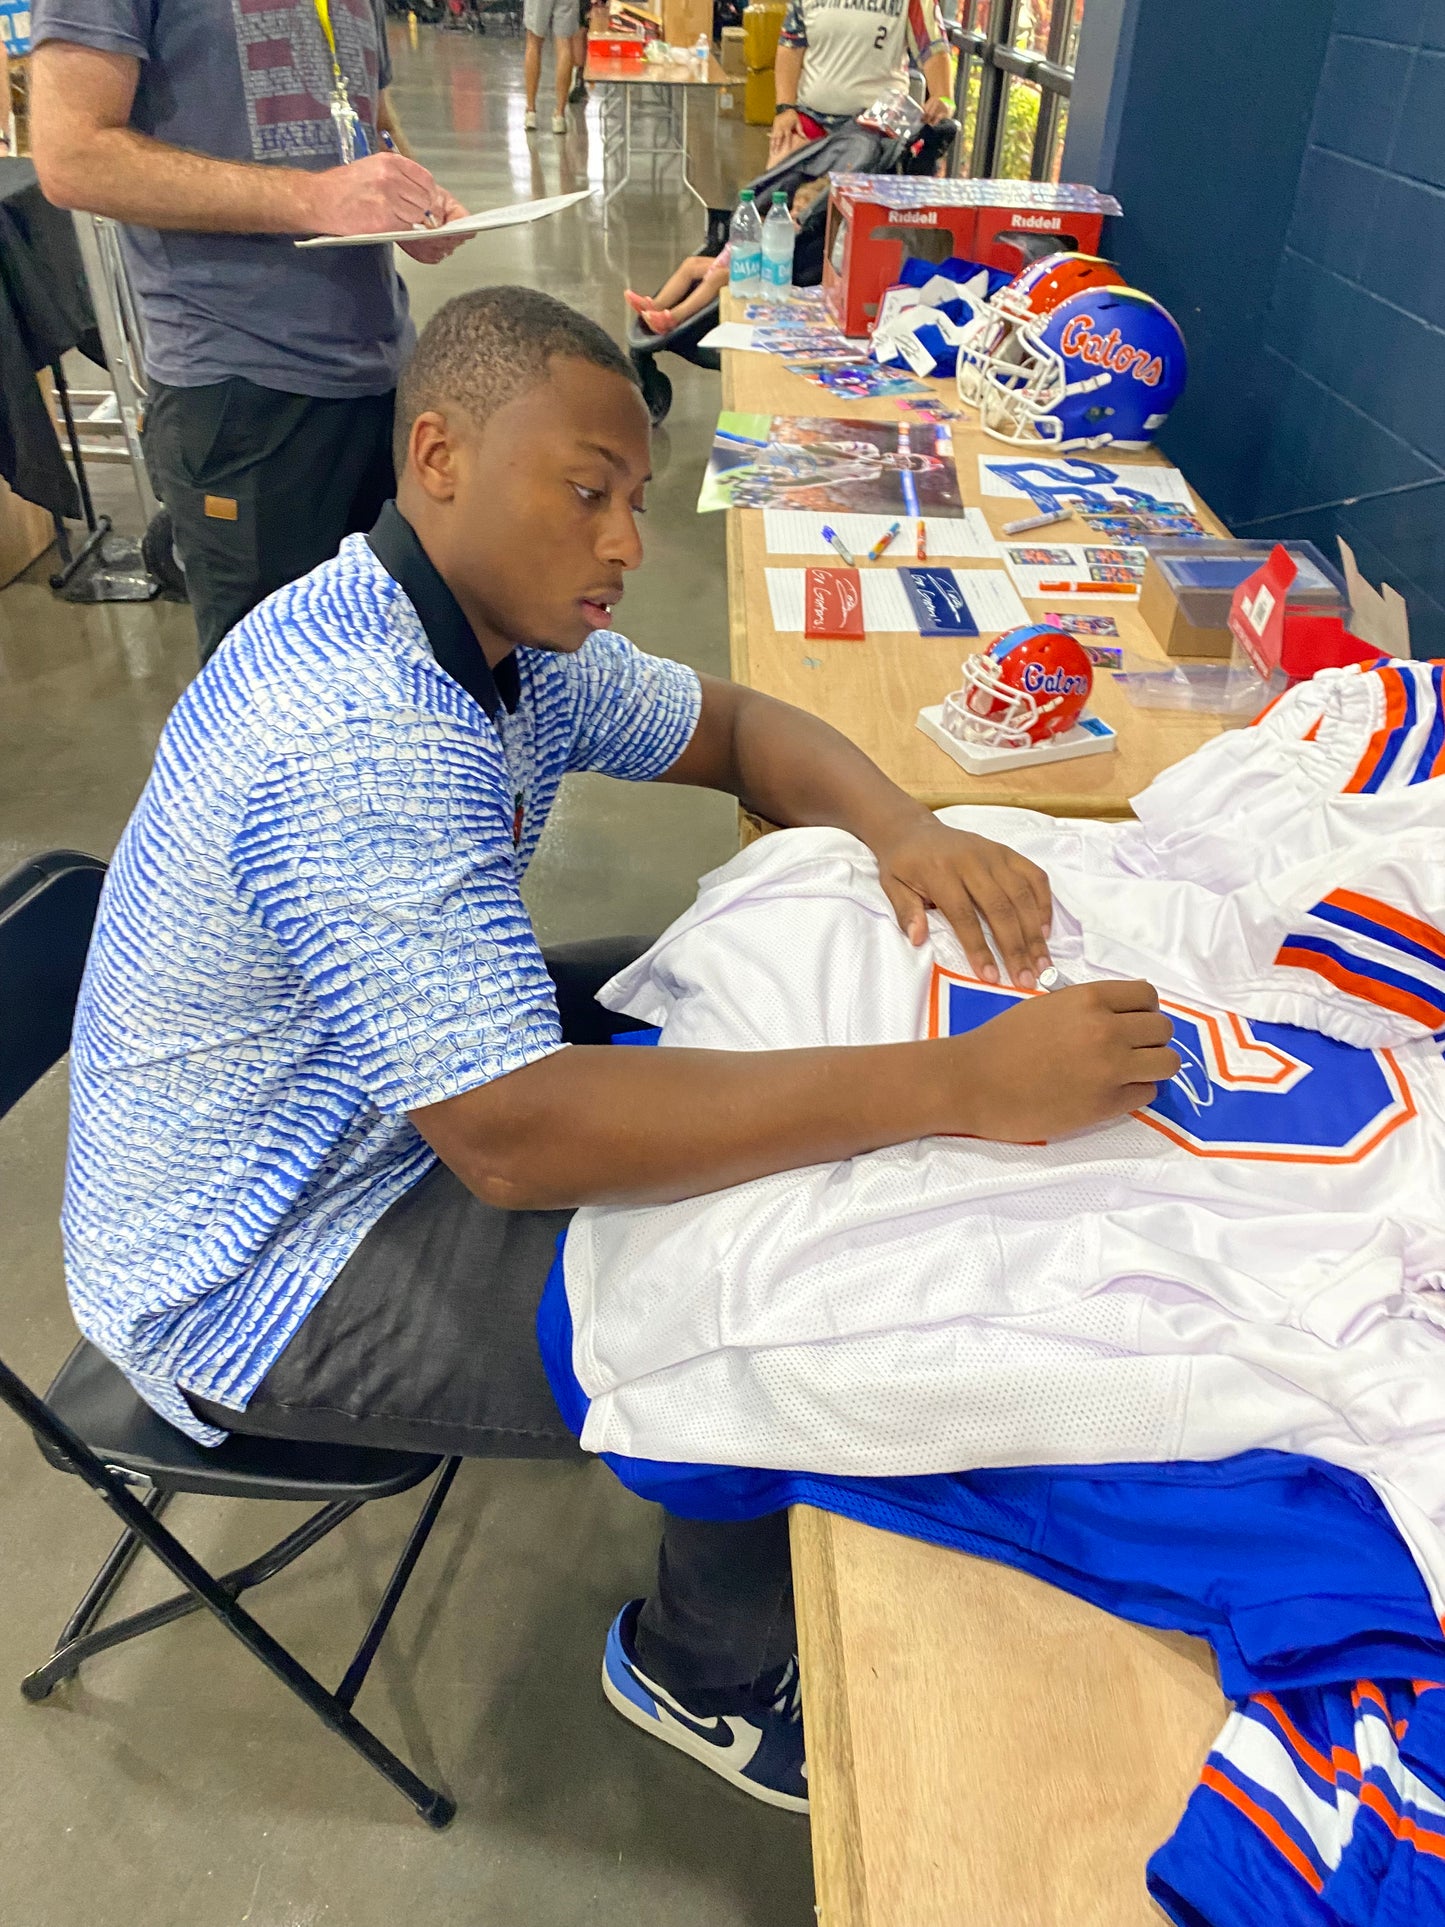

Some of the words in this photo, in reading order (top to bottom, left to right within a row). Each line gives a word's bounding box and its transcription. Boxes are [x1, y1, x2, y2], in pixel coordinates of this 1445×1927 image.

[873, 26, 887, 49] 2
[888, 211, 938, 224] Riddell
[1011, 214, 1061, 230] Riddell
[1060, 314, 1162, 386] Gators
[812, 569, 832, 584] Go
